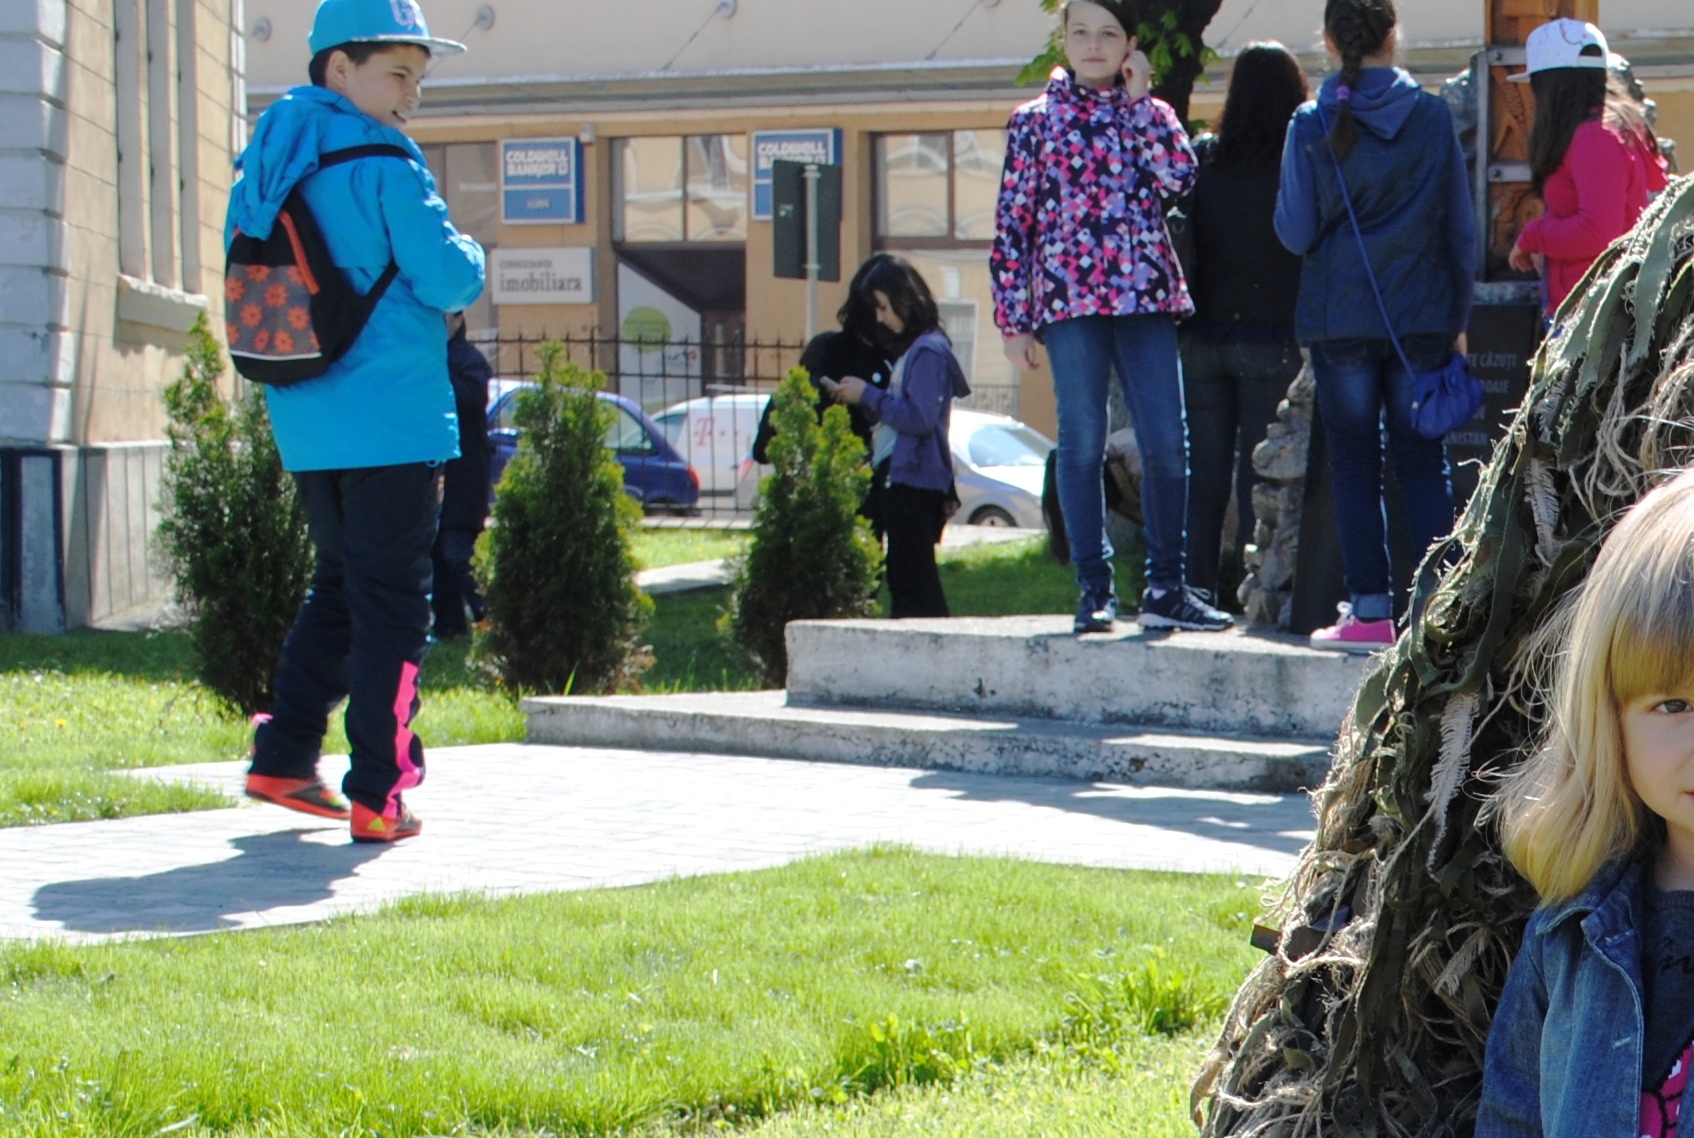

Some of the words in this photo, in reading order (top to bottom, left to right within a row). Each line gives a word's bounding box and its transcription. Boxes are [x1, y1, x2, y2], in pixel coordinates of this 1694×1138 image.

[505, 149, 569, 163] COLDWELL
[507, 161, 557, 178] BANKER
[500, 272, 583, 293] imobiliara
